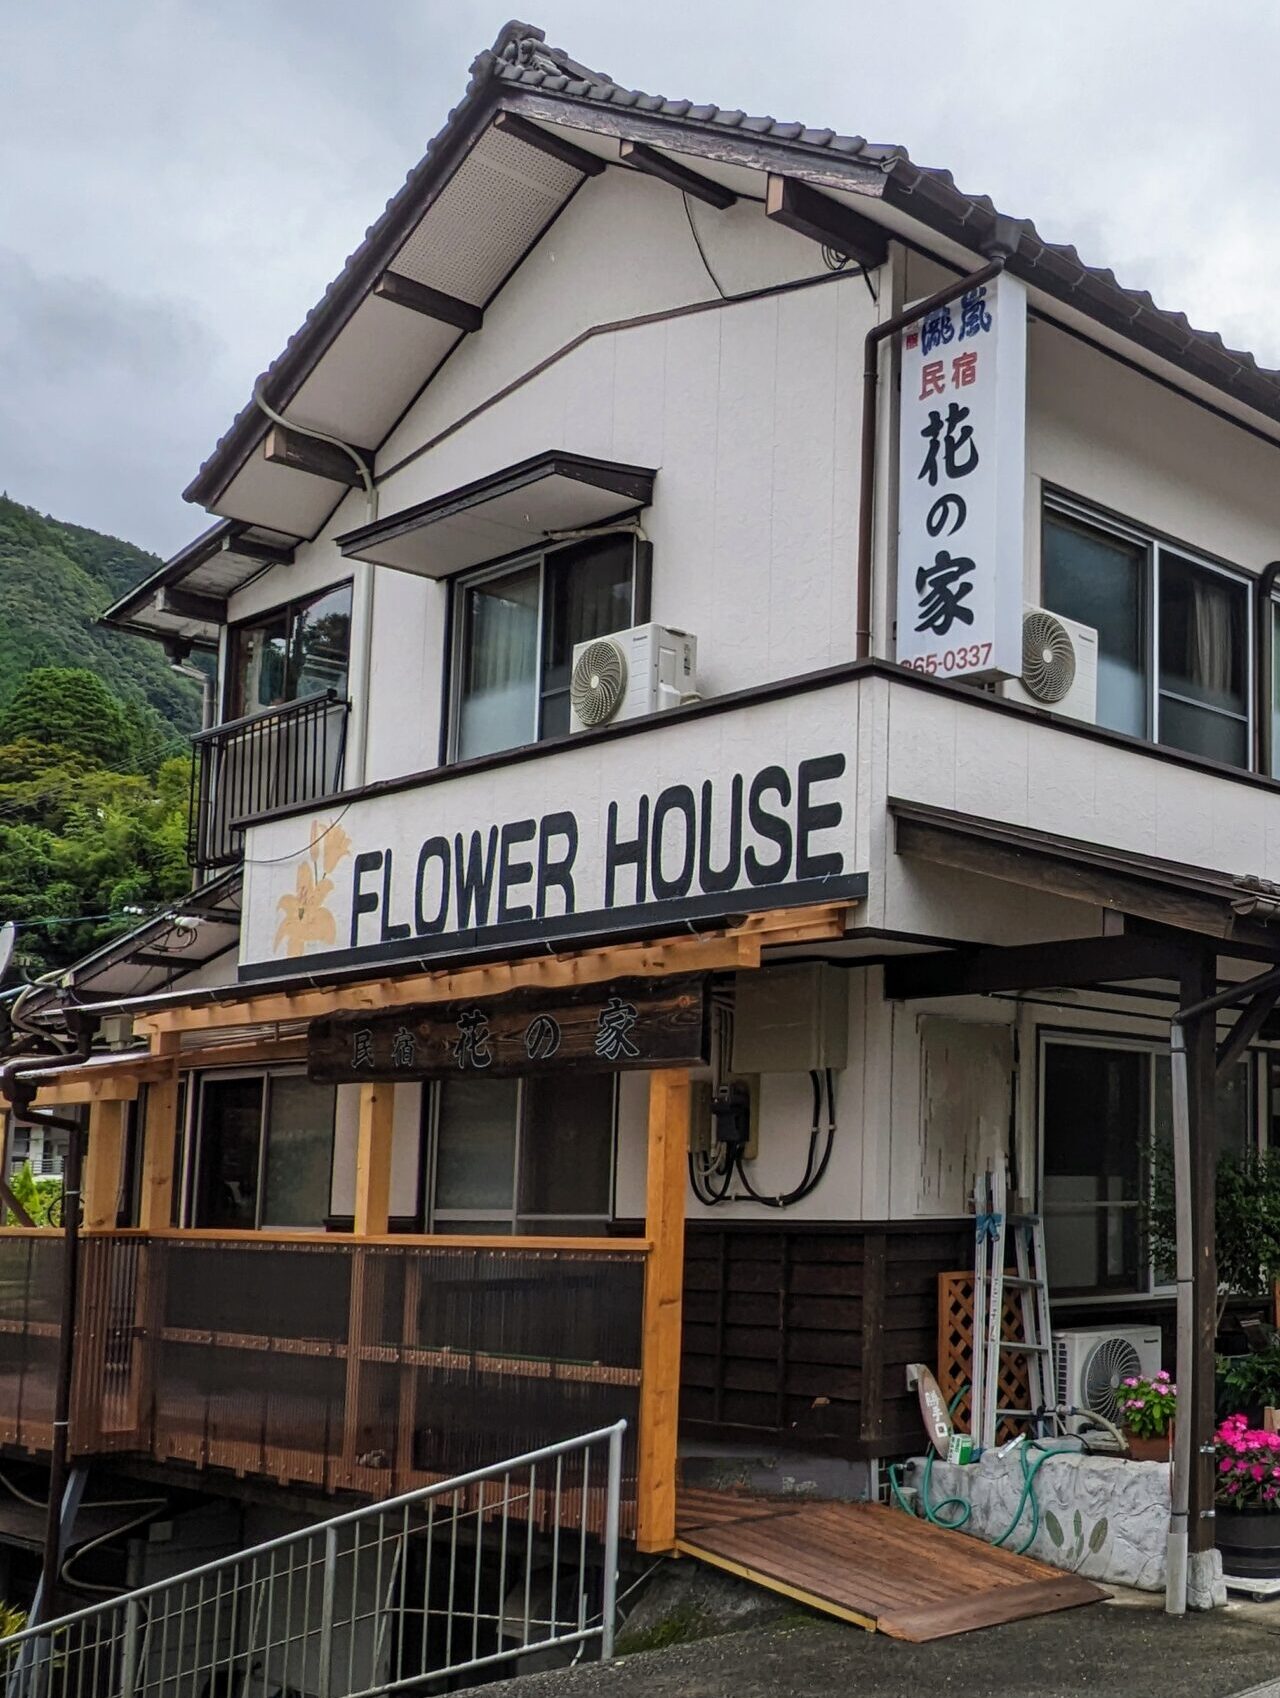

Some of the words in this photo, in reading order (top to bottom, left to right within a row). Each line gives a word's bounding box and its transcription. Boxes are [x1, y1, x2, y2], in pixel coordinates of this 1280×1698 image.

[918, 351, 978, 400] 民宿
[914, 402, 979, 636] 花の家
[350, 810, 579, 947] FLOWER
[604, 752, 846, 909] HOUSE
[351, 1028, 417, 1070] 民宿
[452, 997, 641, 1069] 花の家
